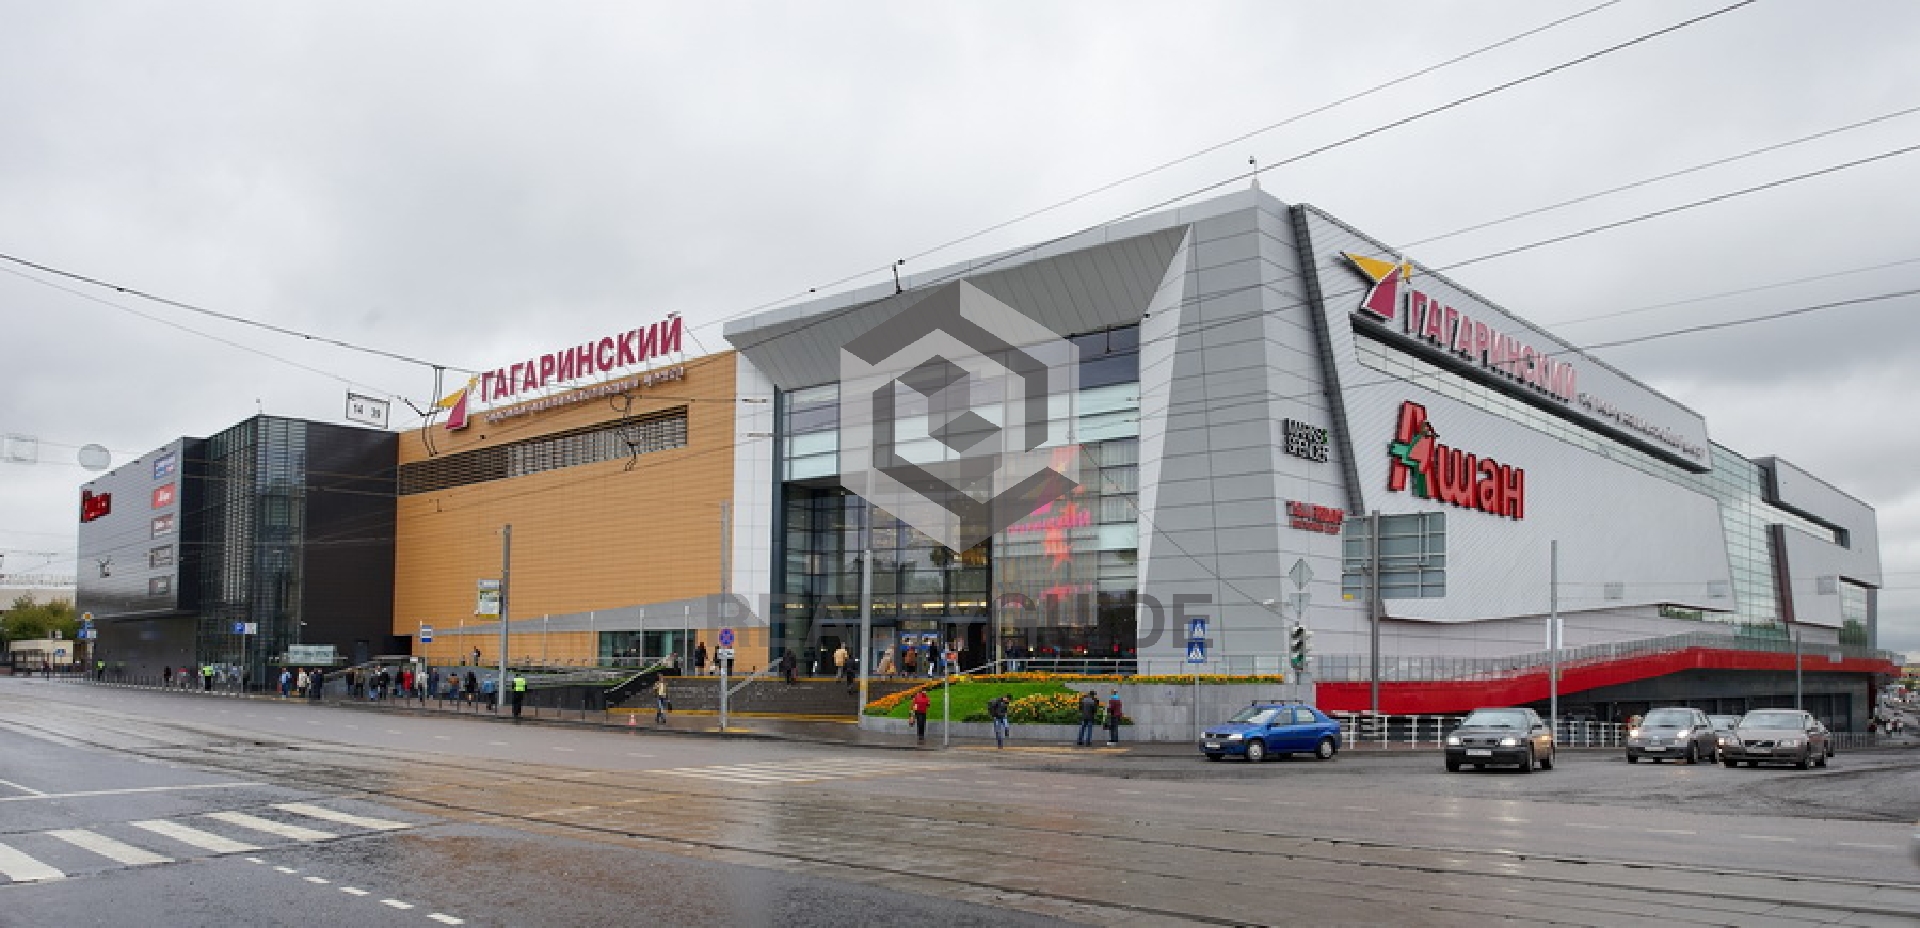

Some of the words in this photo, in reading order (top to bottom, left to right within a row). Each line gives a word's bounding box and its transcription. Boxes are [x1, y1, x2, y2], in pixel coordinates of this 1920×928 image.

[481, 310, 684, 402] ГАГАРИНСКИЙ
[1408, 288, 1578, 401] ГАГАРИНСКИЙ
[1387, 400, 1525, 520] Ашан
